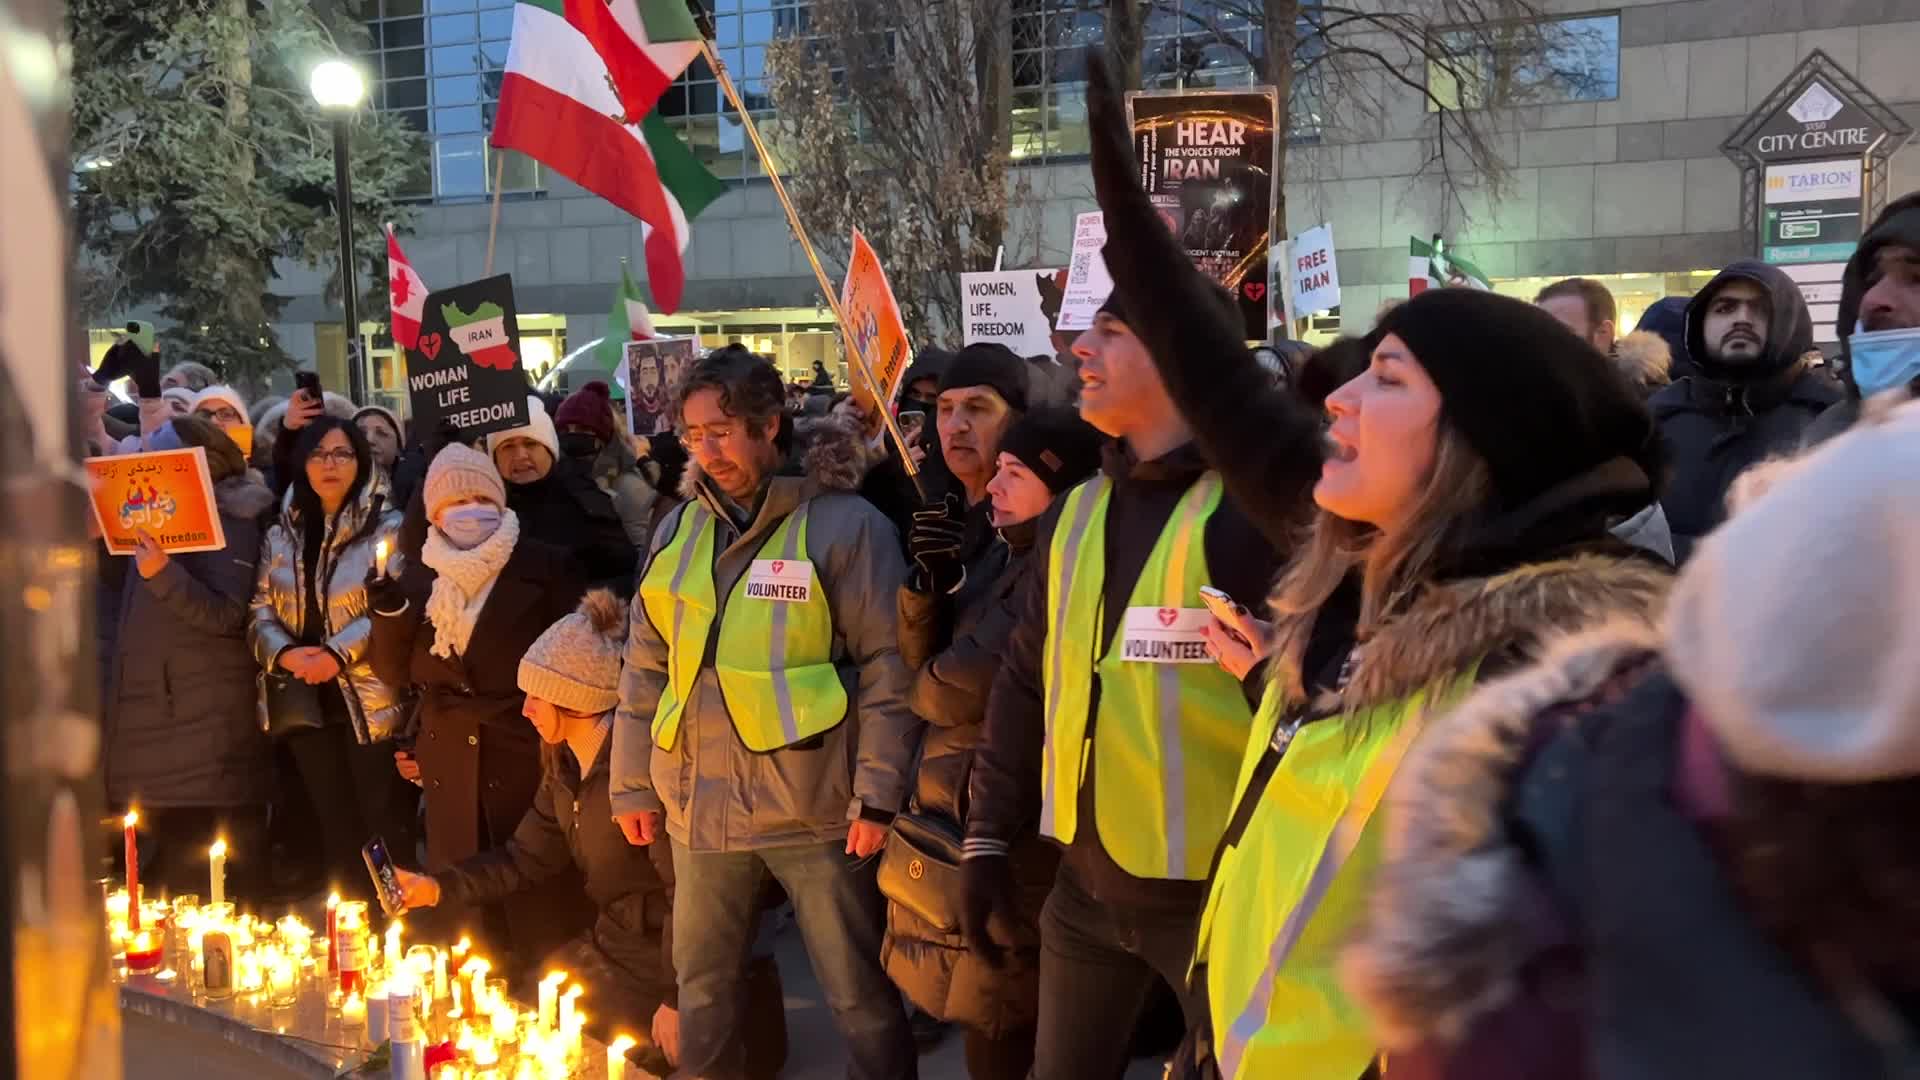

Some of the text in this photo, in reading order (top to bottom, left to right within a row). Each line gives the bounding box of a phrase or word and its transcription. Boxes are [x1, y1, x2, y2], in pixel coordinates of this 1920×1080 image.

[1177, 119, 1245, 146] HEAR
[1757, 127, 1869, 153] CITY CENTRE
[1164, 147, 1241, 157] THE VOICES FROM
[1163, 158, 1220, 180] IRAN
[1788, 171, 1852, 187] TARION
[1296, 248, 1328, 273] FREE
[969, 282, 1017, 296] WOMEN,
[1300, 271, 1331, 294] IRAN
[468, 328, 493, 343] IRAN
[971, 322, 1025, 336] FREEDOM
[410, 365, 469, 392] WOMAN
[438, 386, 471, 408] LIFE
[447, 401, 515, 429] REEDOM
[747, 582, 806, 600] VOLUNTEER
